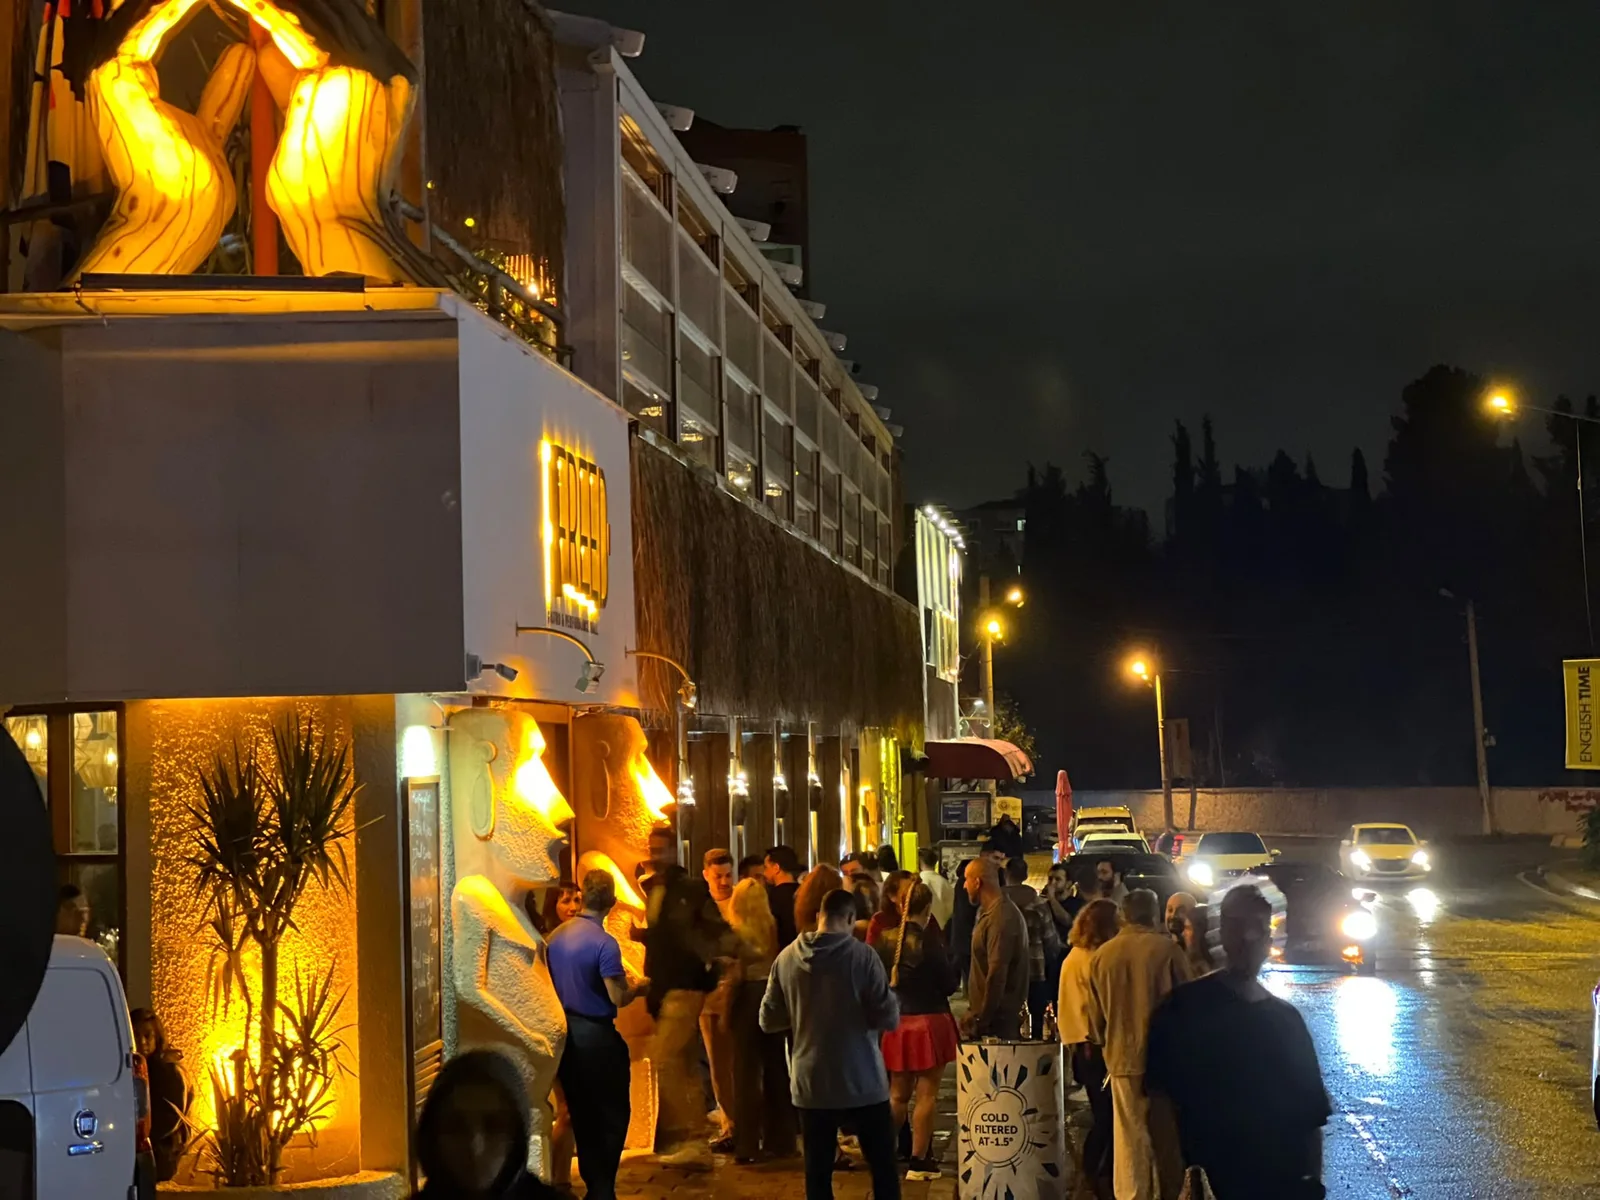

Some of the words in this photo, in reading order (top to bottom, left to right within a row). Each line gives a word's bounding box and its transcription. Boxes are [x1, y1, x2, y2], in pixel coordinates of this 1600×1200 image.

[1577, 665, 1591, 699] TIME
[1579, 703, 1592, 763] ENGLISH
[980, 1113, 1009, 1123] COLD
[974, 1125, 1018, 1135] FILTERED
